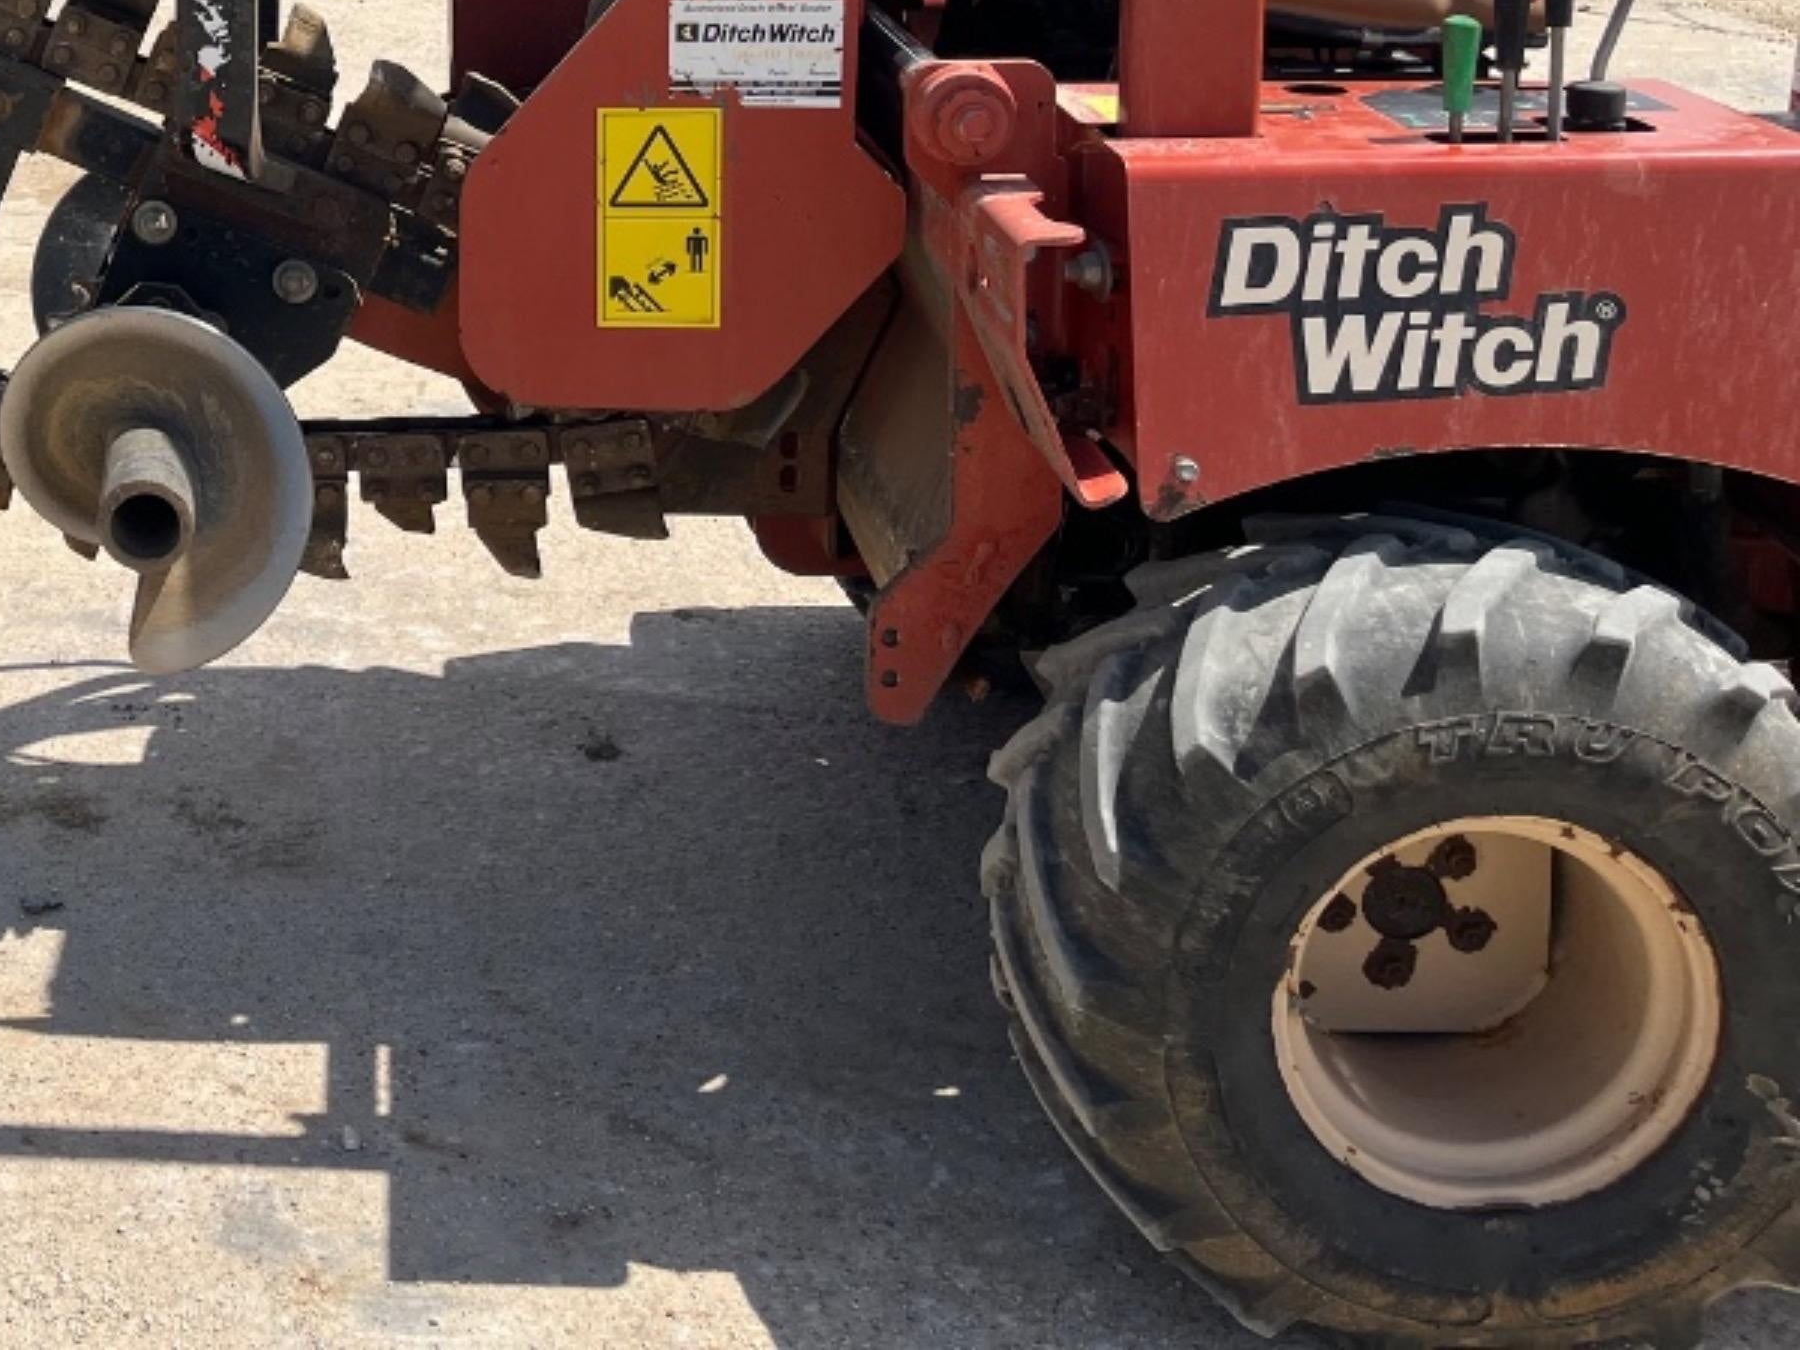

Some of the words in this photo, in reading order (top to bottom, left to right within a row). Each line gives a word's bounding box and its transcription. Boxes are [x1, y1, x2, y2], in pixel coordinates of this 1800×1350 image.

[702, 23, 765, 43] Ditch
[769, 23, 836, 43] Witch
[1218, 214, 1507, 307] Ditch
